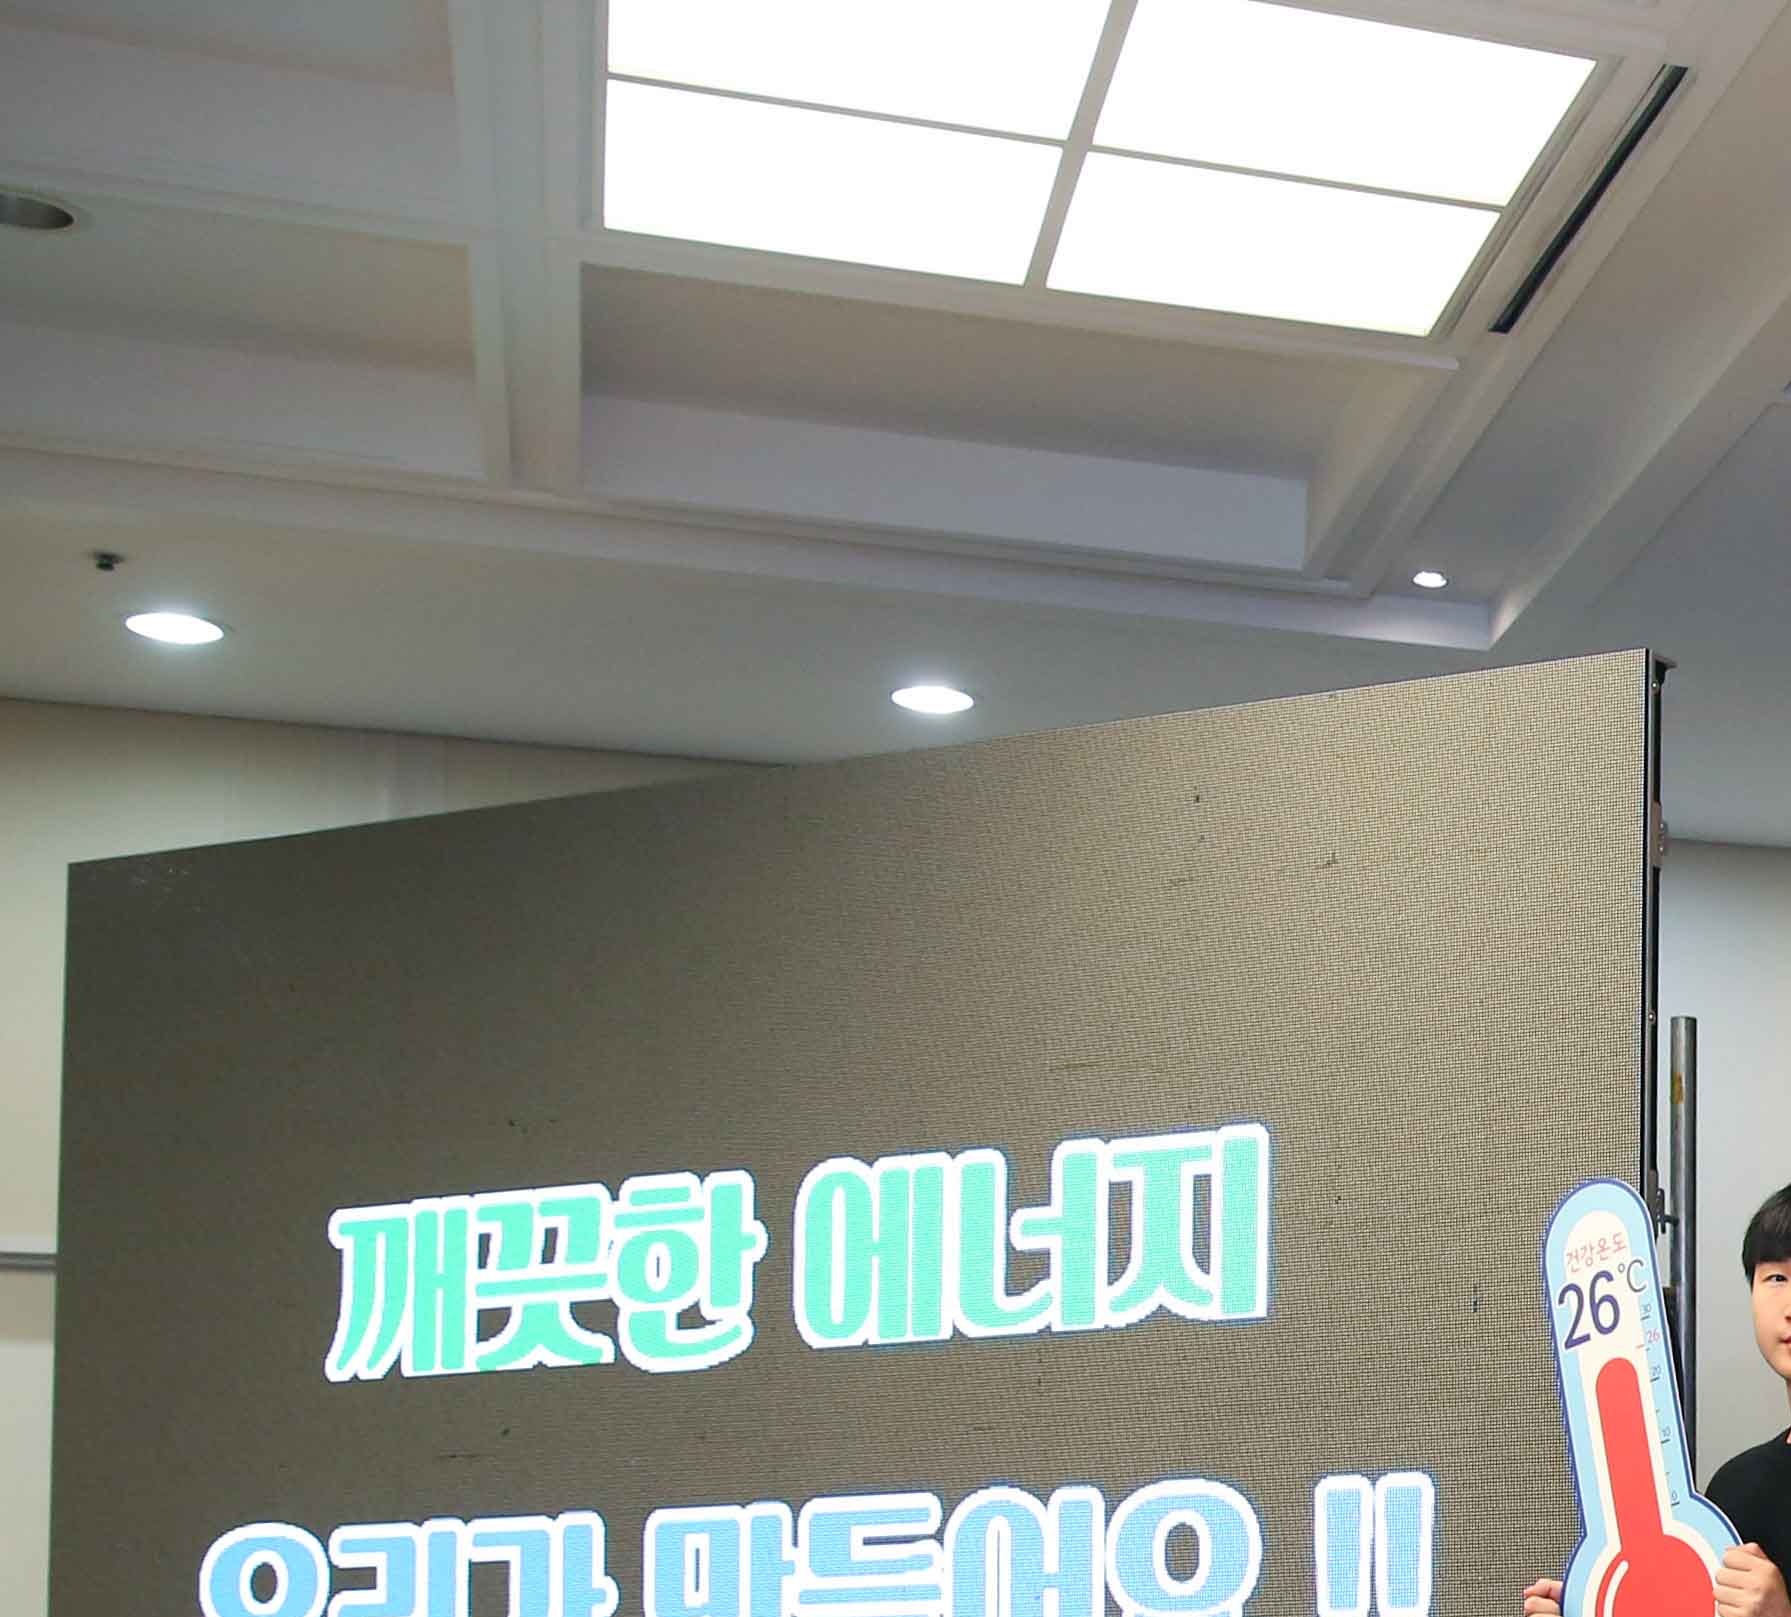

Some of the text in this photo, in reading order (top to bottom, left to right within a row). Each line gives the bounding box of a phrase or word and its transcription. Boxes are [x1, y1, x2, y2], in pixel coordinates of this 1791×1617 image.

[325, 1122, 1272, 1382] 깨끗한 에너지
[1566, 1231, 1627, 1273] 건강온도
